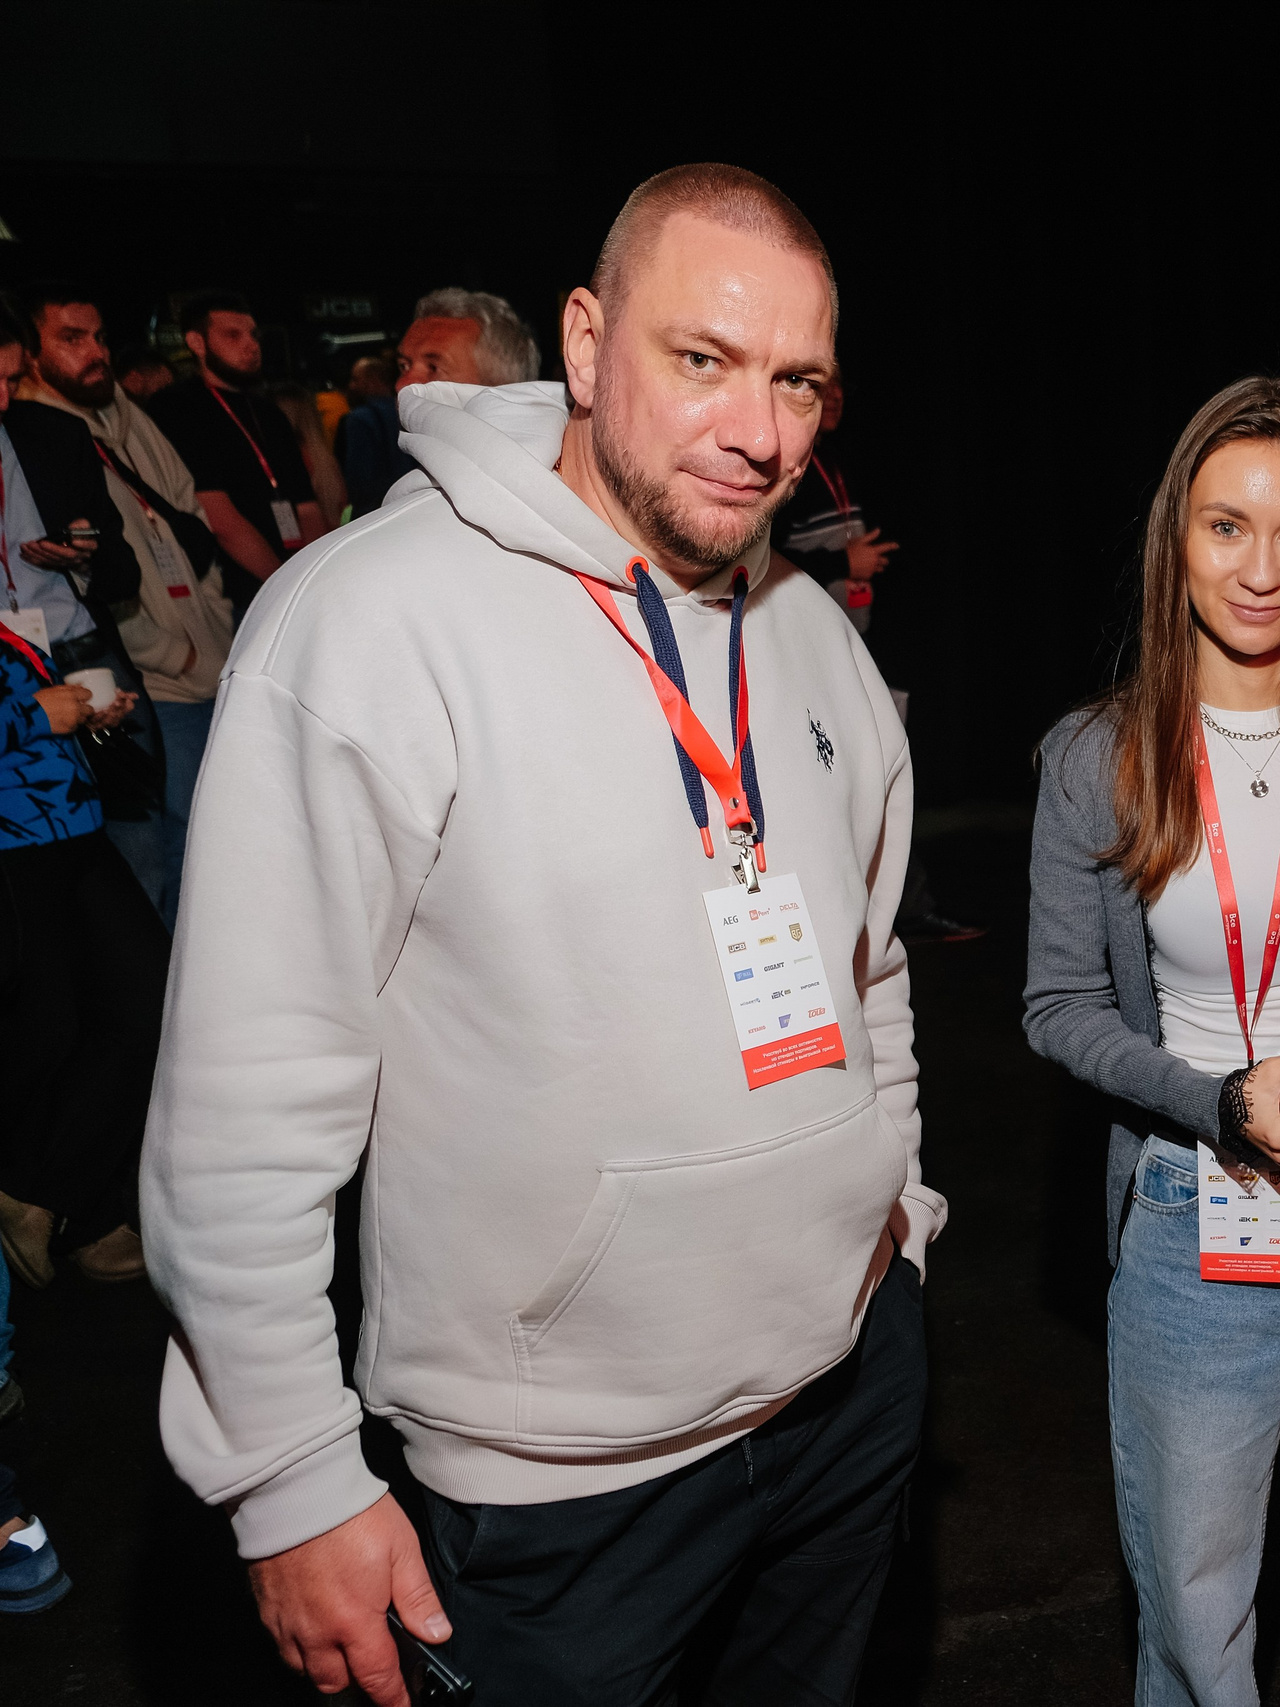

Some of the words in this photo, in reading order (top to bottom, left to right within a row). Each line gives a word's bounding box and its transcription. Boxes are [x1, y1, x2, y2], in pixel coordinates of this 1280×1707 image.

[1211, 822, 1219, 837] Все
[723, 915, 739, 926] AEG
[1229, 913, 1237, 928] Все
[1268, 931, 1277, 945] Все
[728, 942, 746, 953] JCB
[763, 962, 785, 972] GIGANT
